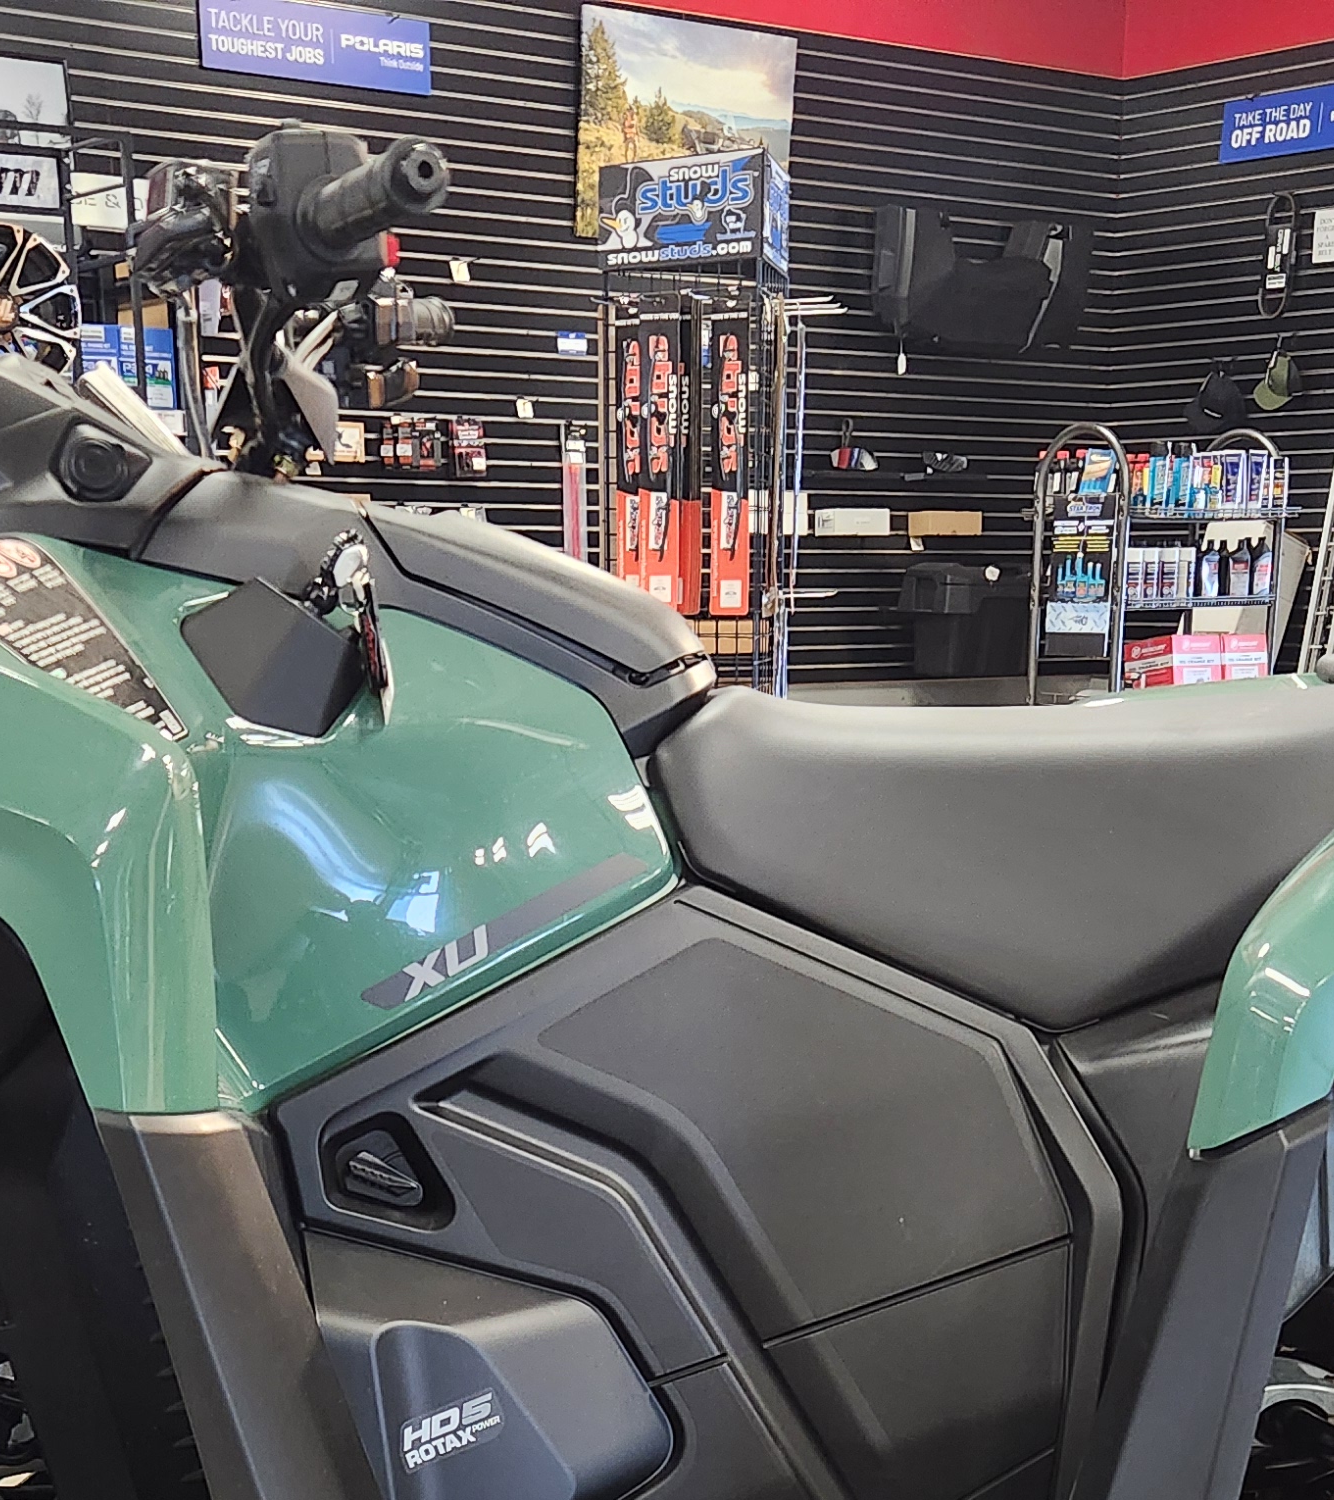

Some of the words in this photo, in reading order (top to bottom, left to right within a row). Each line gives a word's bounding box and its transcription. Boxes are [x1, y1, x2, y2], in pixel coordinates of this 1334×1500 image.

[207, 8, 274, 36] TACKLE
[278, 19, 323, 43] YOUR
[208, 34, 283, 59] TOUGHEST
[286, 46, 324, 65] JOBS
[340, 33, 424, 59] POLARIS
[379, 57, 397, 68] Think
[1234, 111, 1263, 127] TAKE
[1265, 106, 1287, 121] THE
[1290, 102, 1313, 118] DAY
[1231, 126, 1261, 149] OFF
[1264, 118, 1311, 144] ROAD
[670, 163, 719, 182] snow
[638, 166, 751, 214] studs
[607, 241, 752, 266] snowstuds.com
[1318, 241, 1334, 249] SPARE
[402, 924, 489, 1002] XU
[405, 1426, 476, 1469] ROTAX
[472, 1415, 501, 1433] POWER
